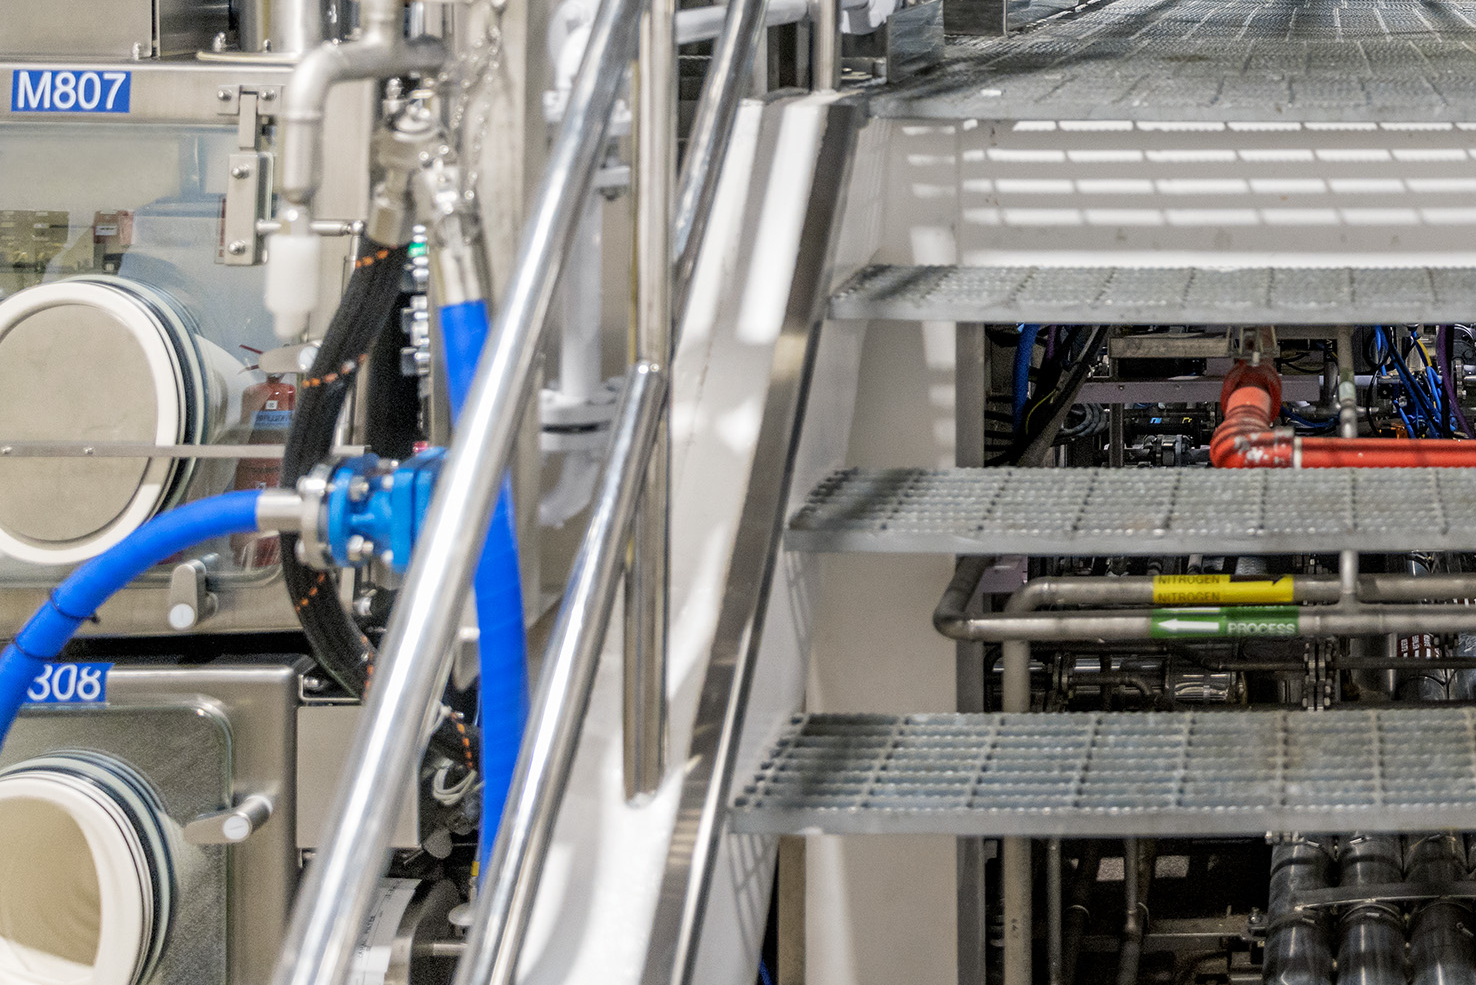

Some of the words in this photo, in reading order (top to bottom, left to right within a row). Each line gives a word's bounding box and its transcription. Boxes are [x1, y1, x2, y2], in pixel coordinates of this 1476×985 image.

[17, 71, 126, 110] M807
[1158, 575, 1220, 584] NITROGEN
[1157, 592, 1220, 602] NITROGEN
[1227, 622, 1296, 634] PROCESS
